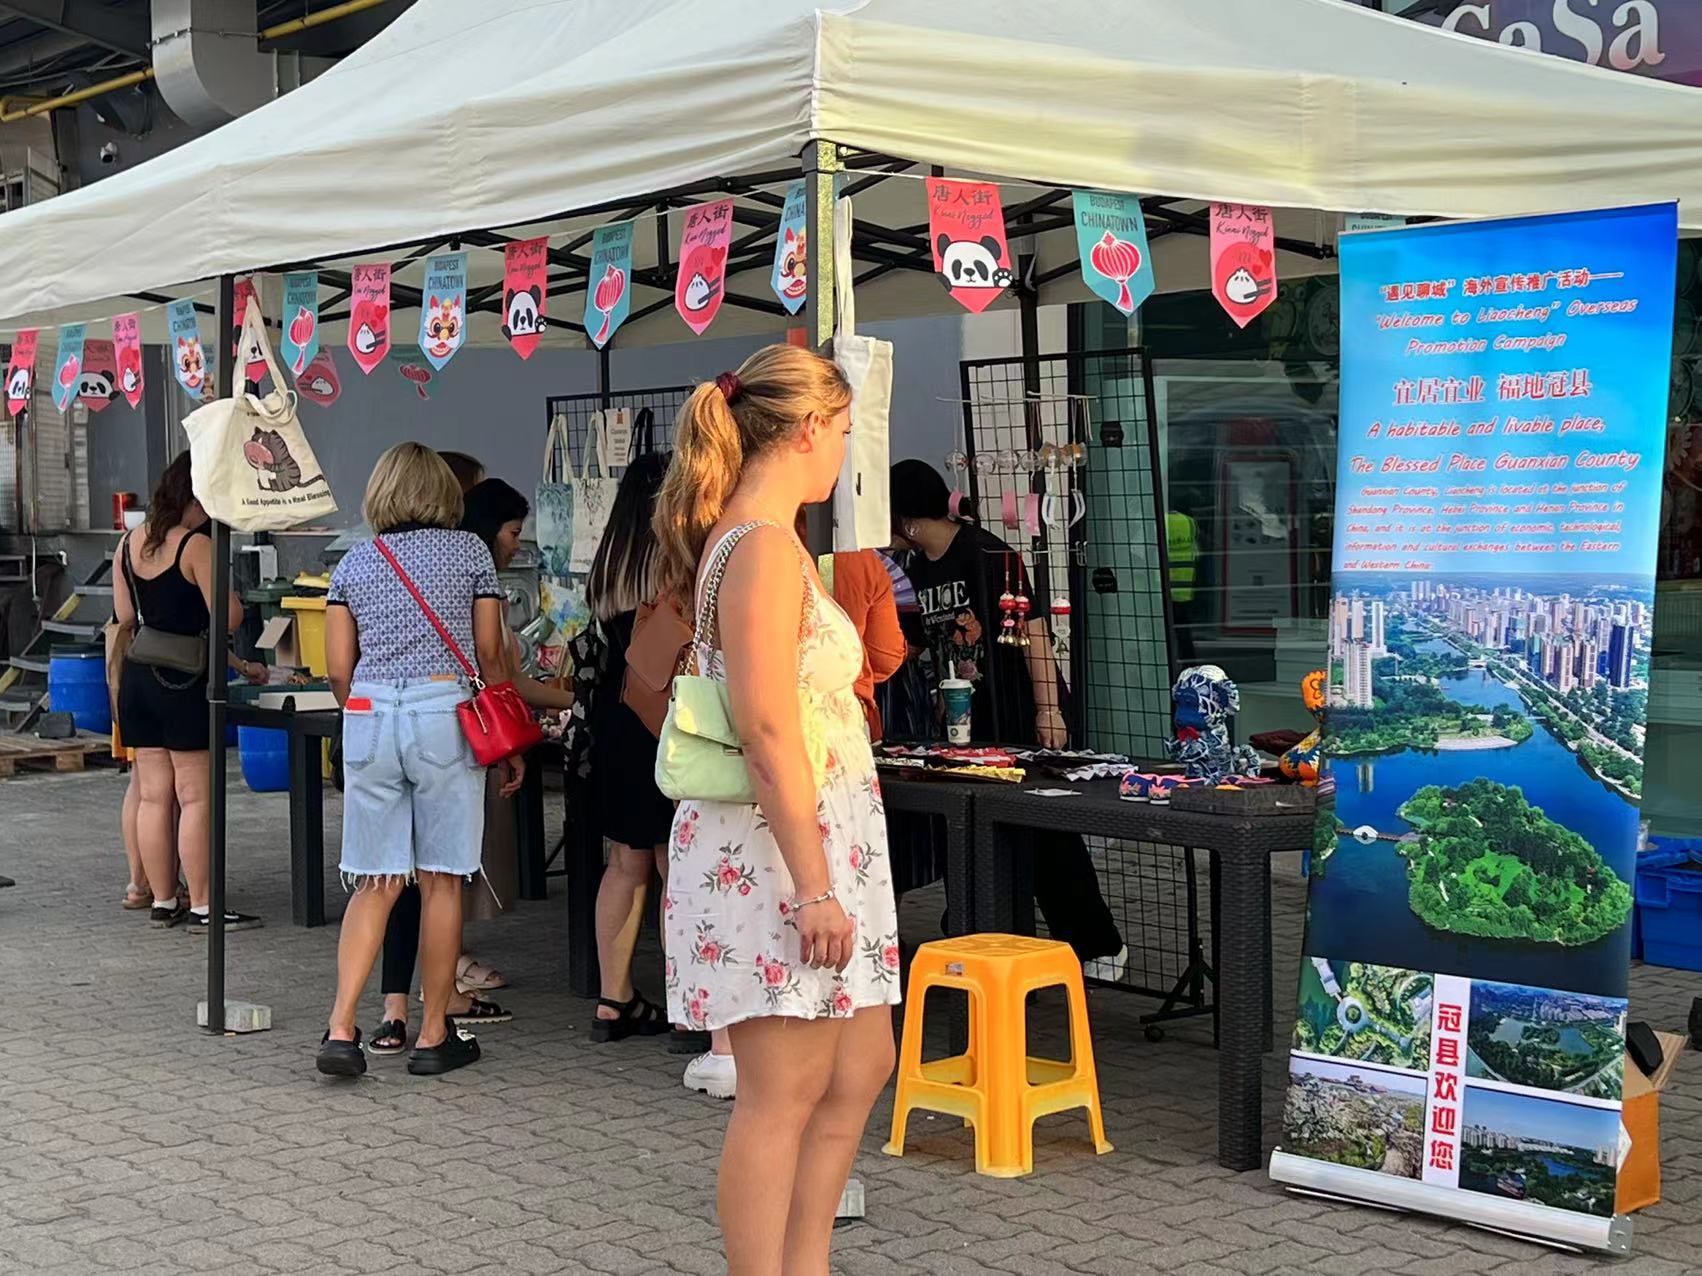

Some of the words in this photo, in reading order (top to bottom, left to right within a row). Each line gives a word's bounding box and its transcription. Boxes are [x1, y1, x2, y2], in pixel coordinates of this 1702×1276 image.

[933, 185, 993, 206] 唐人街
[1089, 195, 1125, 211] BUDAPEST
[1081, 211, 1138, 232] CHINATOWN
[1215, 203, 1268, 224] 唐人街
[428, 274, 464, 290] CHINATOWN
[1452, 309, 1470, 324] to
[1567, 300, 1638, 316] Overseas
[1407, 338, 1487, 354] Promotion
[1493, 332, 1567, 352] Campaign
[1392, 376, 1486, 406] 宜居宜业
[1498, 368, 1592, 401] 福地冠县
[1366, 422, 1381, 438] A
[1386, 420, 1461, 438] habitable
[1466, 416, 1497, 436] and
[1503, 417, 1554, 434] livable
[1558, 416, 1605, 436] place,
[1352, 456, 1374, 473] The
[1380, 455, 1442, 473] Blessed
[1446, 453, 1487, 472] Place
[1494, 452, 1568, 470] Guanxian
[1575, 449, 1640, 471] County
[1488, 484, 1497, 495] is
[1500, 484, 1535, 495] located
[1551, 483, 1568, 494] the
[1611, 479, 1627, 493] of
[1347, 503, 1388, 516] Shandong
[1468, 502, 1509, 514] Province
[1512, 504, 1532, 514] and
[1535, 503, 1565, 514] Henan
[1567, 500, 1608, 513] Province
[1612, 501, 1624, 513] in
[1373, 522, 1392, 533] and
[1394, 522, 1404, 533] it
[1420, 523, 1432, 533] at
[1435, 522, 1452, 533] the
[1494, 521, 1508, 534] of
[1401, 541, 1420, 552] and
[1423, 541, 1459, 552] cultural
[1463, 541, 1509, 554] exchanges
[1514, 541, 1556, 552] between
[1561, 540, 1576, 552] the
[1580, 539, 1620, 552] Eastern
[1343, 559, 1358, 570] and
[1360, 559, 1400, 570] Western
[1429, 1002, 1463, 1172] 冠县欢迎您
